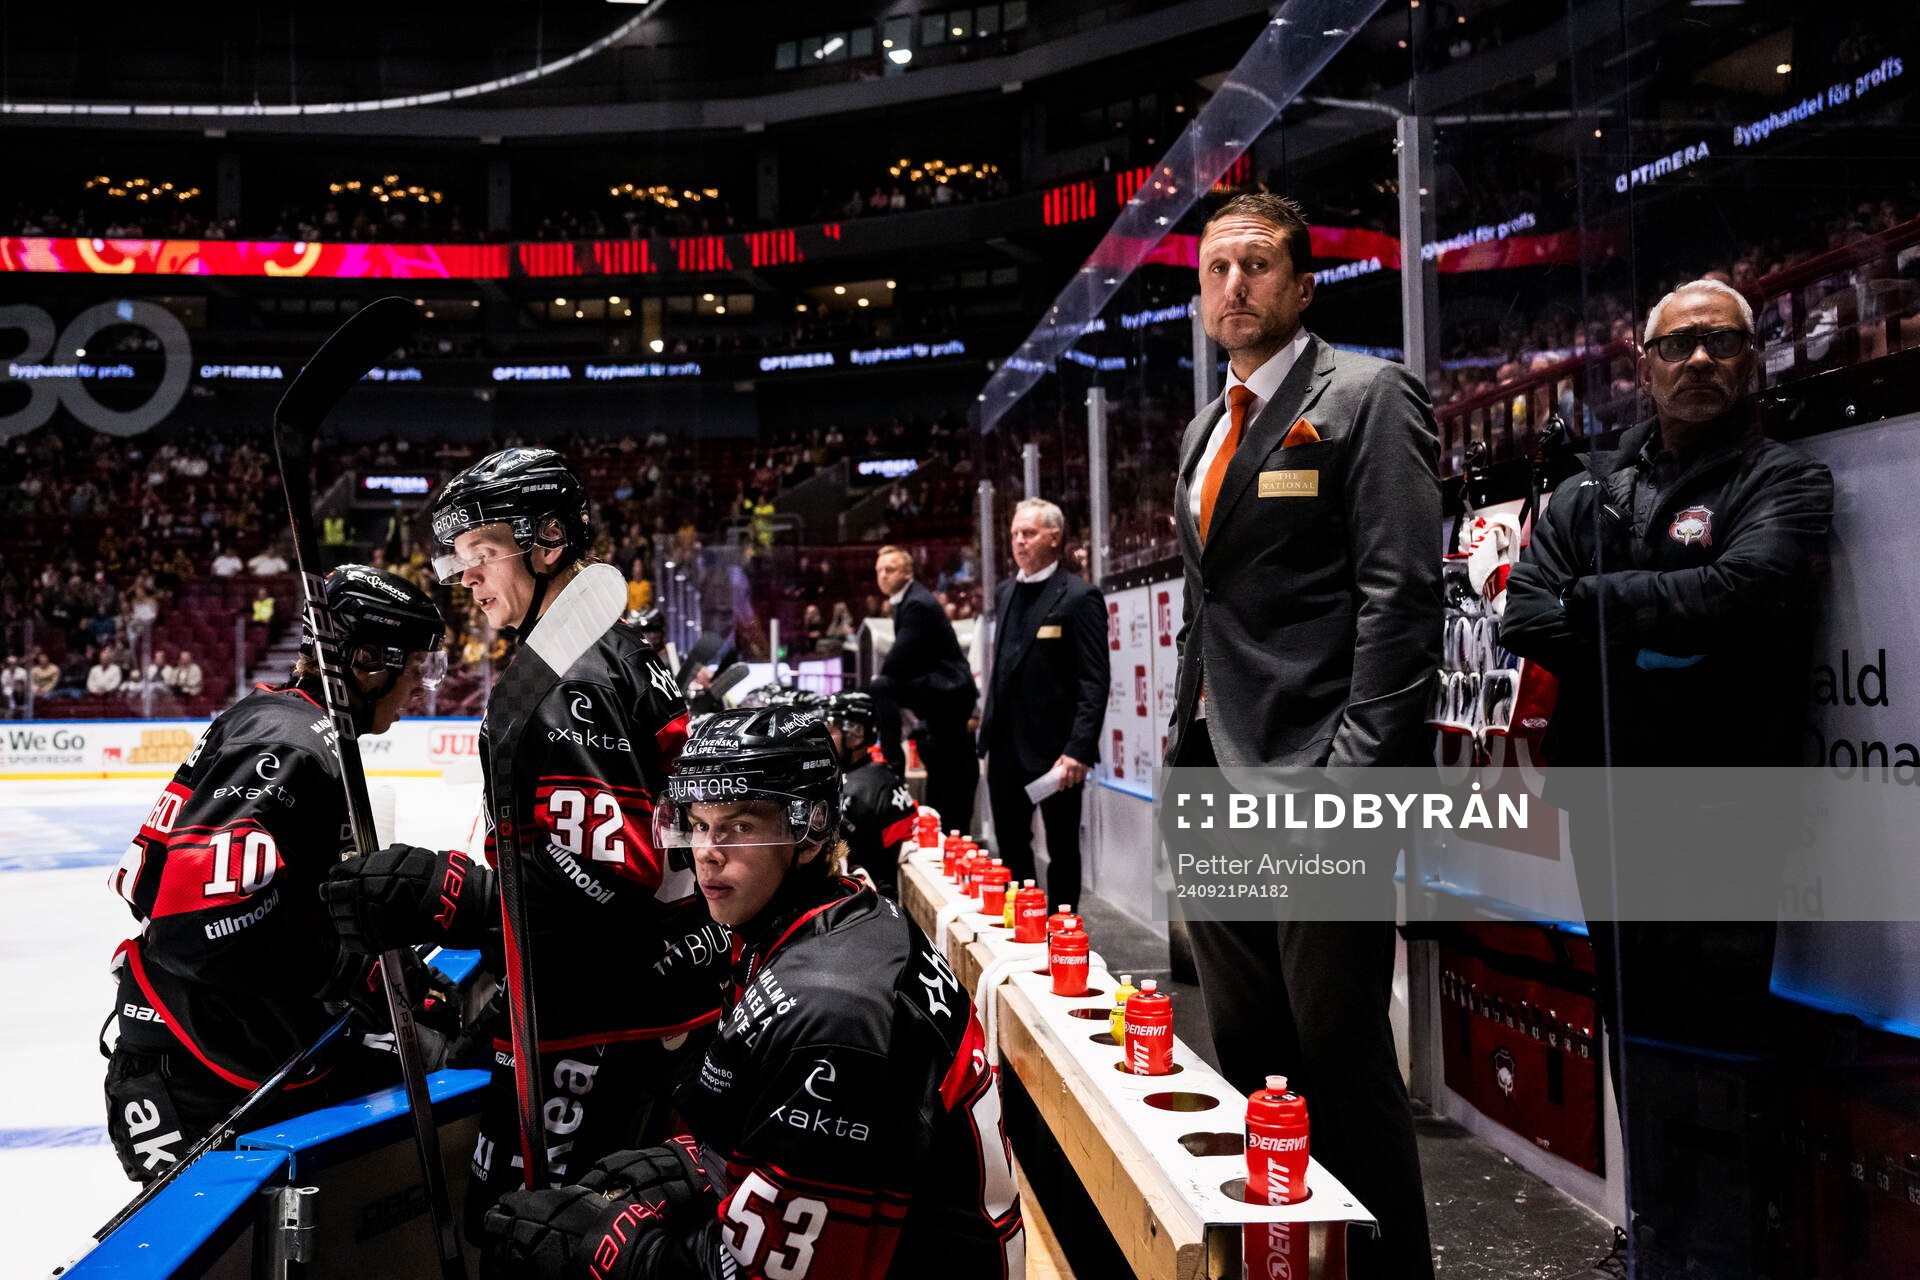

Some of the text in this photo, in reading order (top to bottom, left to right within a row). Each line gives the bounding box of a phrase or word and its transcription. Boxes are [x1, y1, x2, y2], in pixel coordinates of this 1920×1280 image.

[1615, 56, 1904, 193] OPTIMERA Bygghandel för profis
[1314, 256, 1381, 286] PTIMERA
[200, 364, 283, 380] OPTIMERA
[9, 729, 85, 750] We Go
[700, 738, 739, 749] SVENSKA
[213, 784, 296, 808] exakta
[669, 777, 748, 800] BJURFORS
[549, 788, 627, 864] 32
[203, 829, 278, 897] 10
[204, 888, 281, 940] tillmobil
[1129, 1024, 1167, 1037] ENERVIT
[701, 1066, 731, 1088] Gruppen
[1259, 1135, 1308, 1152] ENERVIT
[722, 1170, 829, 1280] 53
